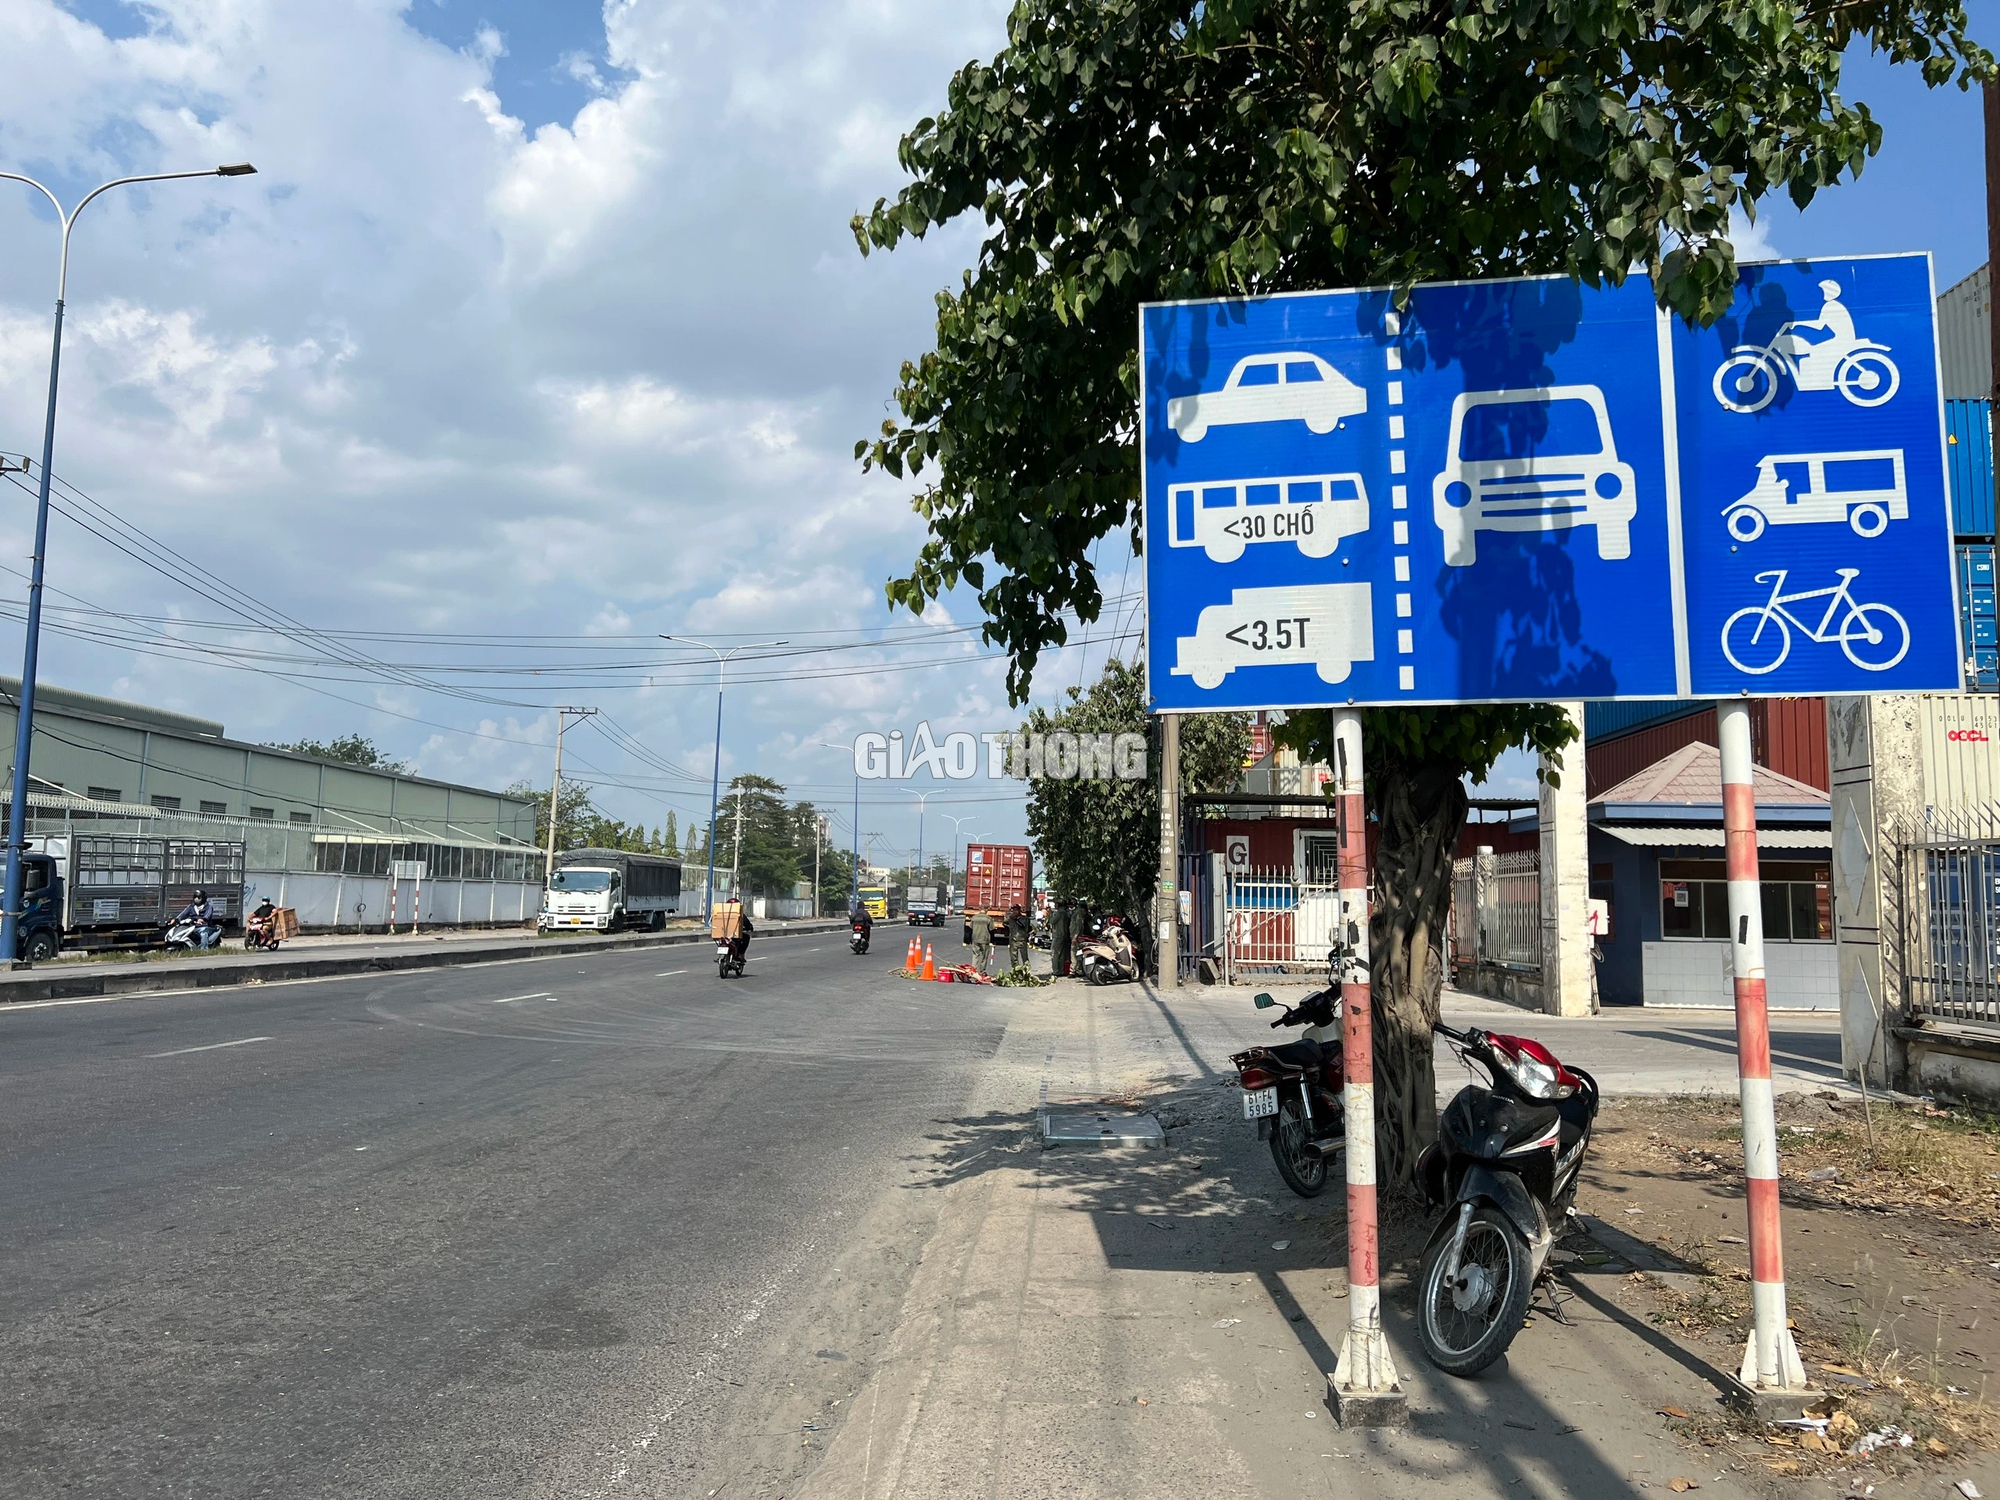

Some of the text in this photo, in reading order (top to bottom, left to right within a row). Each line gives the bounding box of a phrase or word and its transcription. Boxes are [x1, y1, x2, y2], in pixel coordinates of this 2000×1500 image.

[1223, 503, 1314, 539] <30 CHỖ
[1225, 617, 1311, 651] <3.5T
[1228, 841, 1248, 866] G
[1248, 1090, 1272, 1105] 61-F4
[1249, 1101, 1274, 1117] 5985
